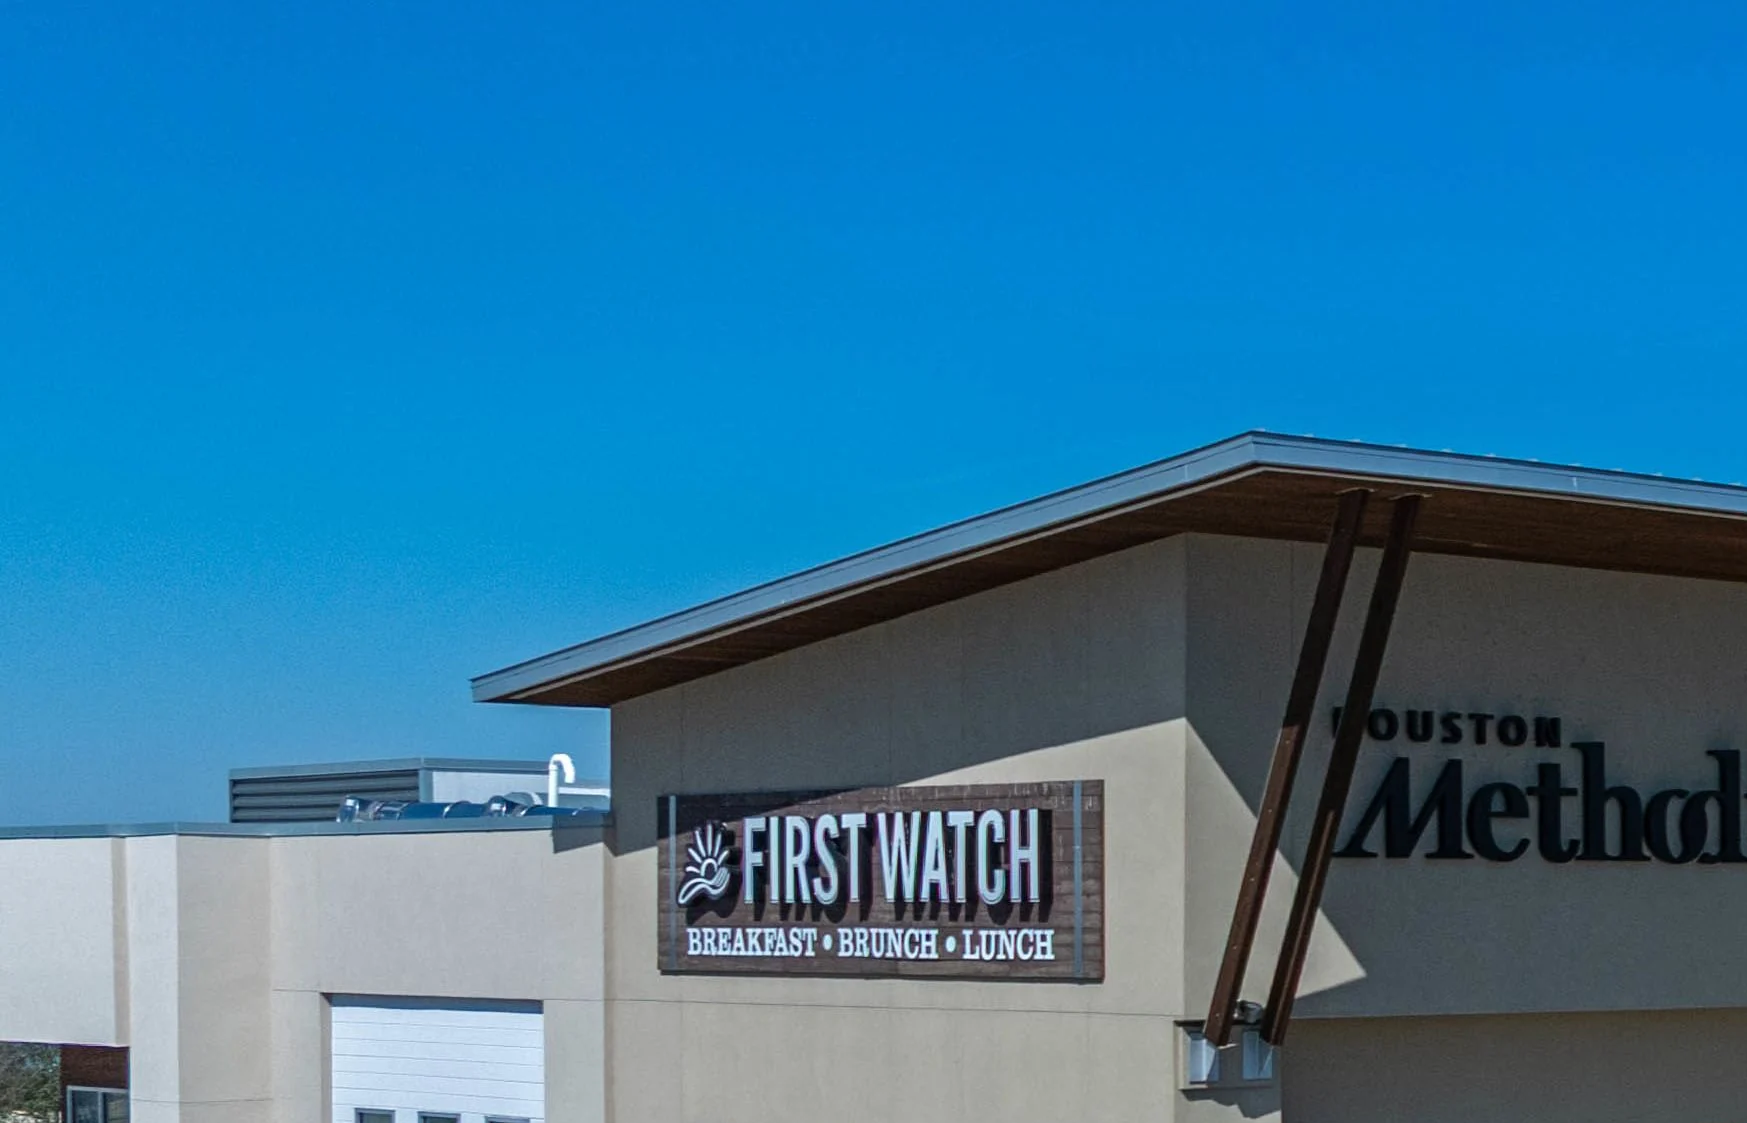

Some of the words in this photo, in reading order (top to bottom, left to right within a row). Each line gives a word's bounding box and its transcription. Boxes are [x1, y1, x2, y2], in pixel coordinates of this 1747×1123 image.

[742, 811, 867, 906] FIRST
[877, 808, 1041, 906] WATCH
[686, 927, 818, 957] BREAKFAST
[837, 928, 939, 960] BRUNCH
[961, 929, 1055, 961] LUNCH
